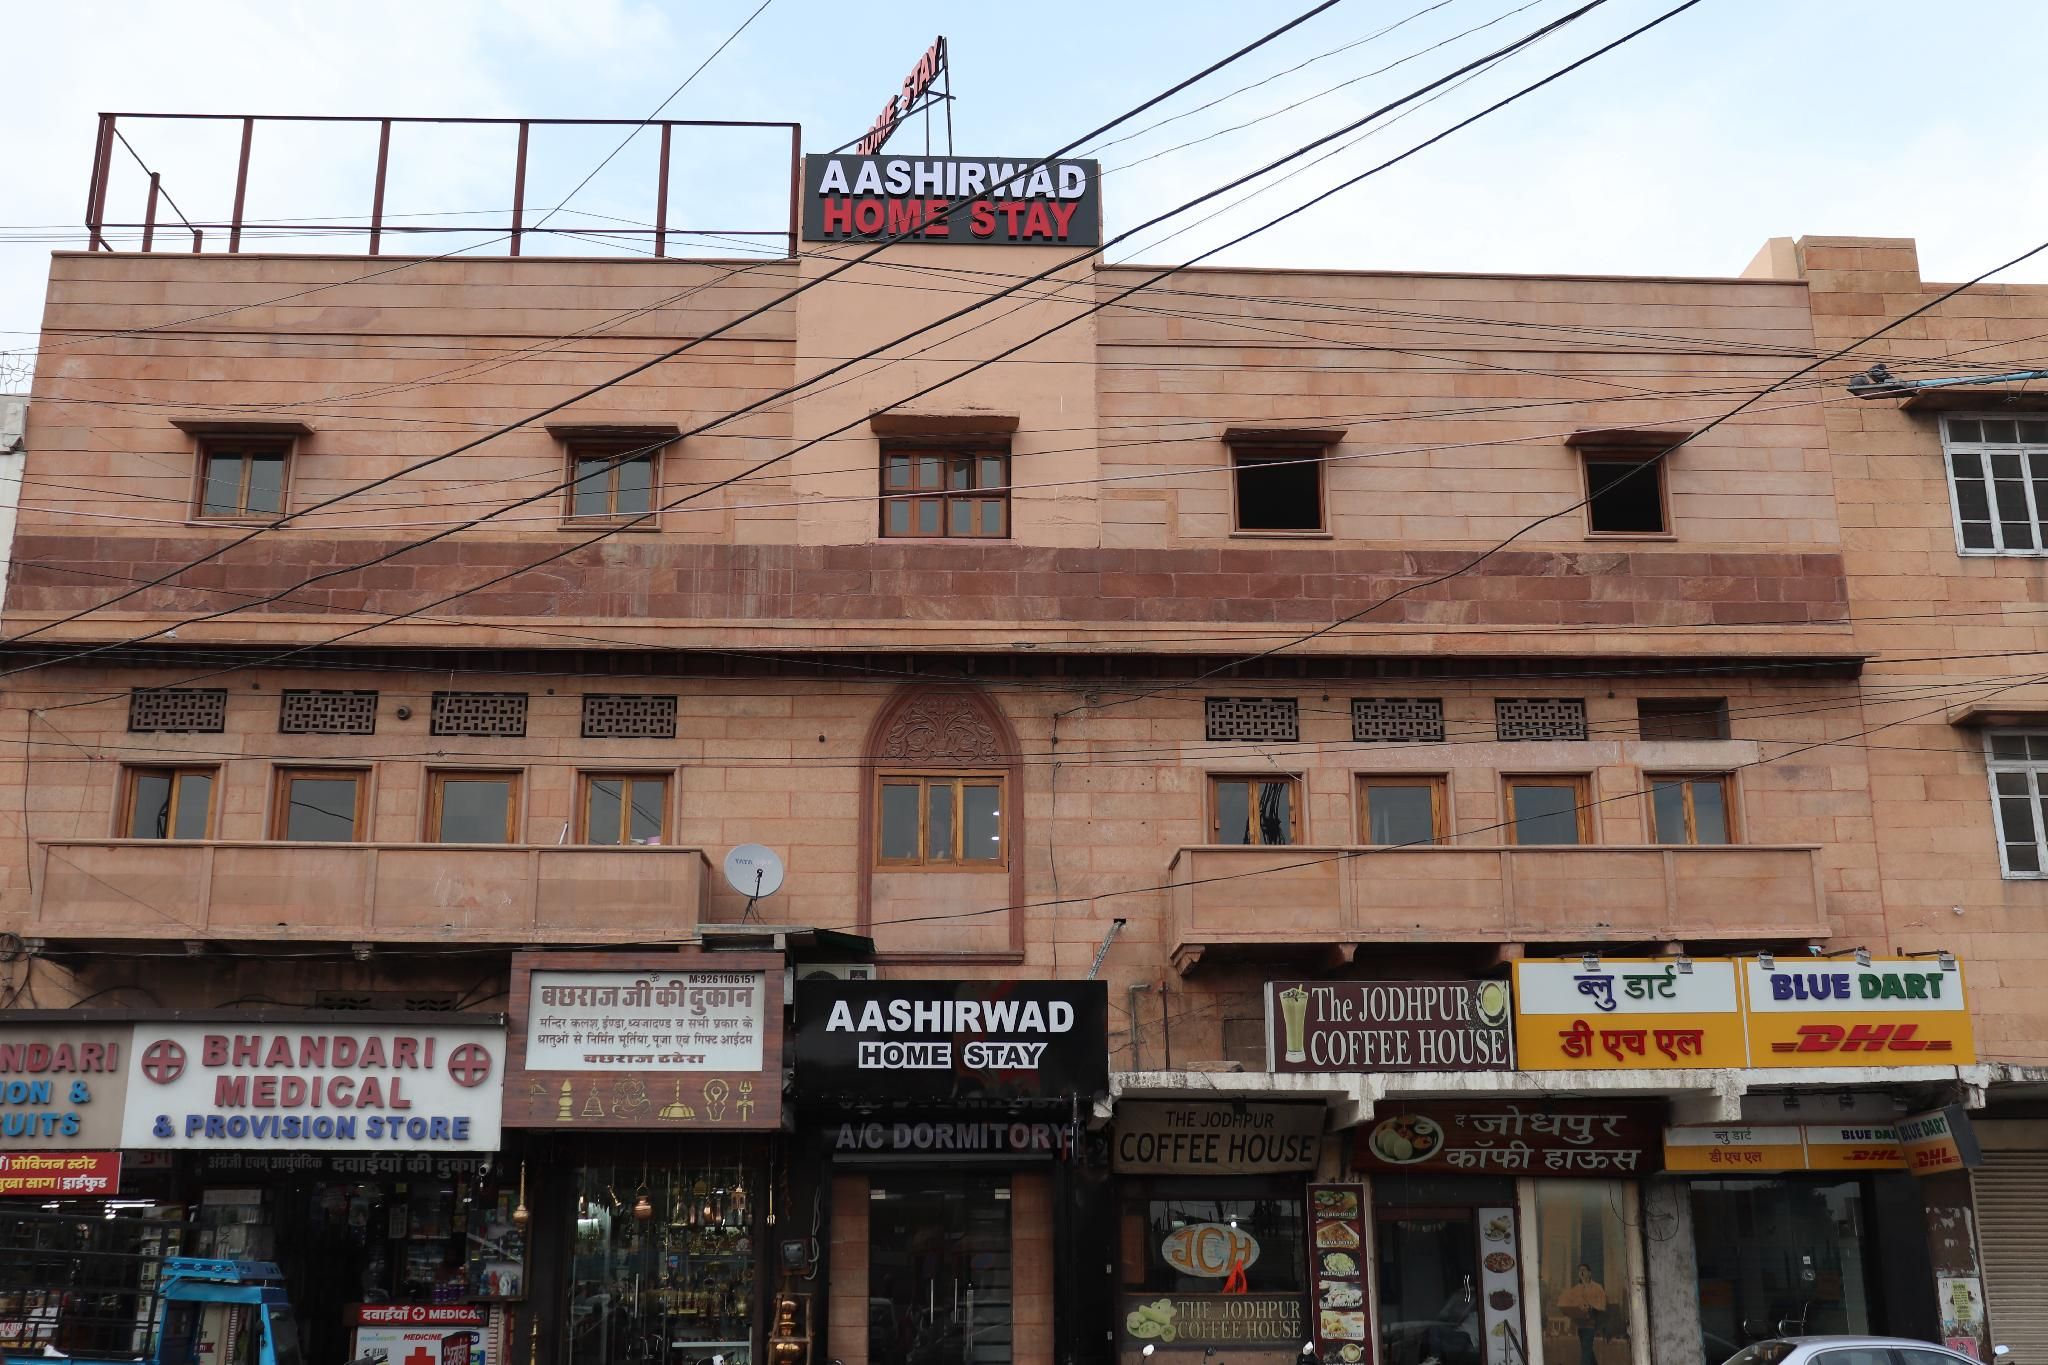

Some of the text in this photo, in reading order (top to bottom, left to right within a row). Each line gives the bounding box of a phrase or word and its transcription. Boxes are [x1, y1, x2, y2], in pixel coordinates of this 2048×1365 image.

[901, 35, 942, 111] STAY
[818, 159, 1087, 200] AASHIRWAD
[823, 197, 1078, 241] HOME STAY
[689, 974, 755, 984] M:9261106151
[1574, 965, 1677, 1011] ब्लु डार्ट
[1770, 973, 1944, 1000] BLUE DART
[541, 980, 755, 1015] बछराज जी की दुकान
[1311, 986, 1472, 1022] The JODHPUR
[540, 1015, 567, 1029] मन्दिर
[675, 1018, 684, 1028] व
[688, 1015, 710, 1028] सभी
[713, 1018, 739, 1028] प्रकार
[742, 1015, 754, 1028] के
[826, 999, 1075, 1033] AASHIRWAD
[573, 1031, 583, 1044] से
[586, 1031, 615, 1045] निर्मित
[652, 1034, 672, 1048] पूजा
[720, 1031, 753, 1046] आईटम
[1310, 1029, 1507, 1065] COFFEE HOUSE
[1558, 1020, 1704, 1061] डी एच एल
[1796, 1024, 1929, 1052] DHL
[202, 1035, 436, 1069] BHANDARI
[583, 1053, 655, 1063] बछराज
[858, 1041, 1049, 1069] HOME STAY
[69, 1080, 91, 1104] &
[214, 1075, 413, 1109] MEDICAL
[0, 1112, 81, 1137] UITS
[153, 1115, 471, 1140] & PROVISION STORE
[1166, 1111, 1275, 1129] THE JODHPUR
[1470, 1105, 1628, 1145] जोधपुर
[1900, 1117, 1948, 1142] BLUE DART
[836, 1122, 1070, 1149] A/C DORMITORY
[1732, 1127, 1752, 1141] डार्ट
[1841, 1130, 1872, 1140] BLUE
[1119, 1133, 1315, 1164] COFFEE HOUSE
[1444, 1140, 1642, 1171] कॉफी हाऊस
[1709, 1150, 1762, 1163] डी एच एल
[1850, 1150, 1901, 1161] DHL
[1915, 1147, 1953, 1168] DHL
[11, 1155, 65, 1170] प्रोविजन
[67, 1156, 98, 1170] स्टोर
[406, 1153, 433, 1174] की
[437, 1157, 485, 1179] दुका
[26, 1177, 56, 1189] साग
[1171, 1226, 1253, 1273] JCH
[1222, 1301, 1301, 1319] JODHPUR
[403, 1333, 443, 1341] MEDICINE
[1177, 1320, 1302, 1339] COFFEE HOUSE
